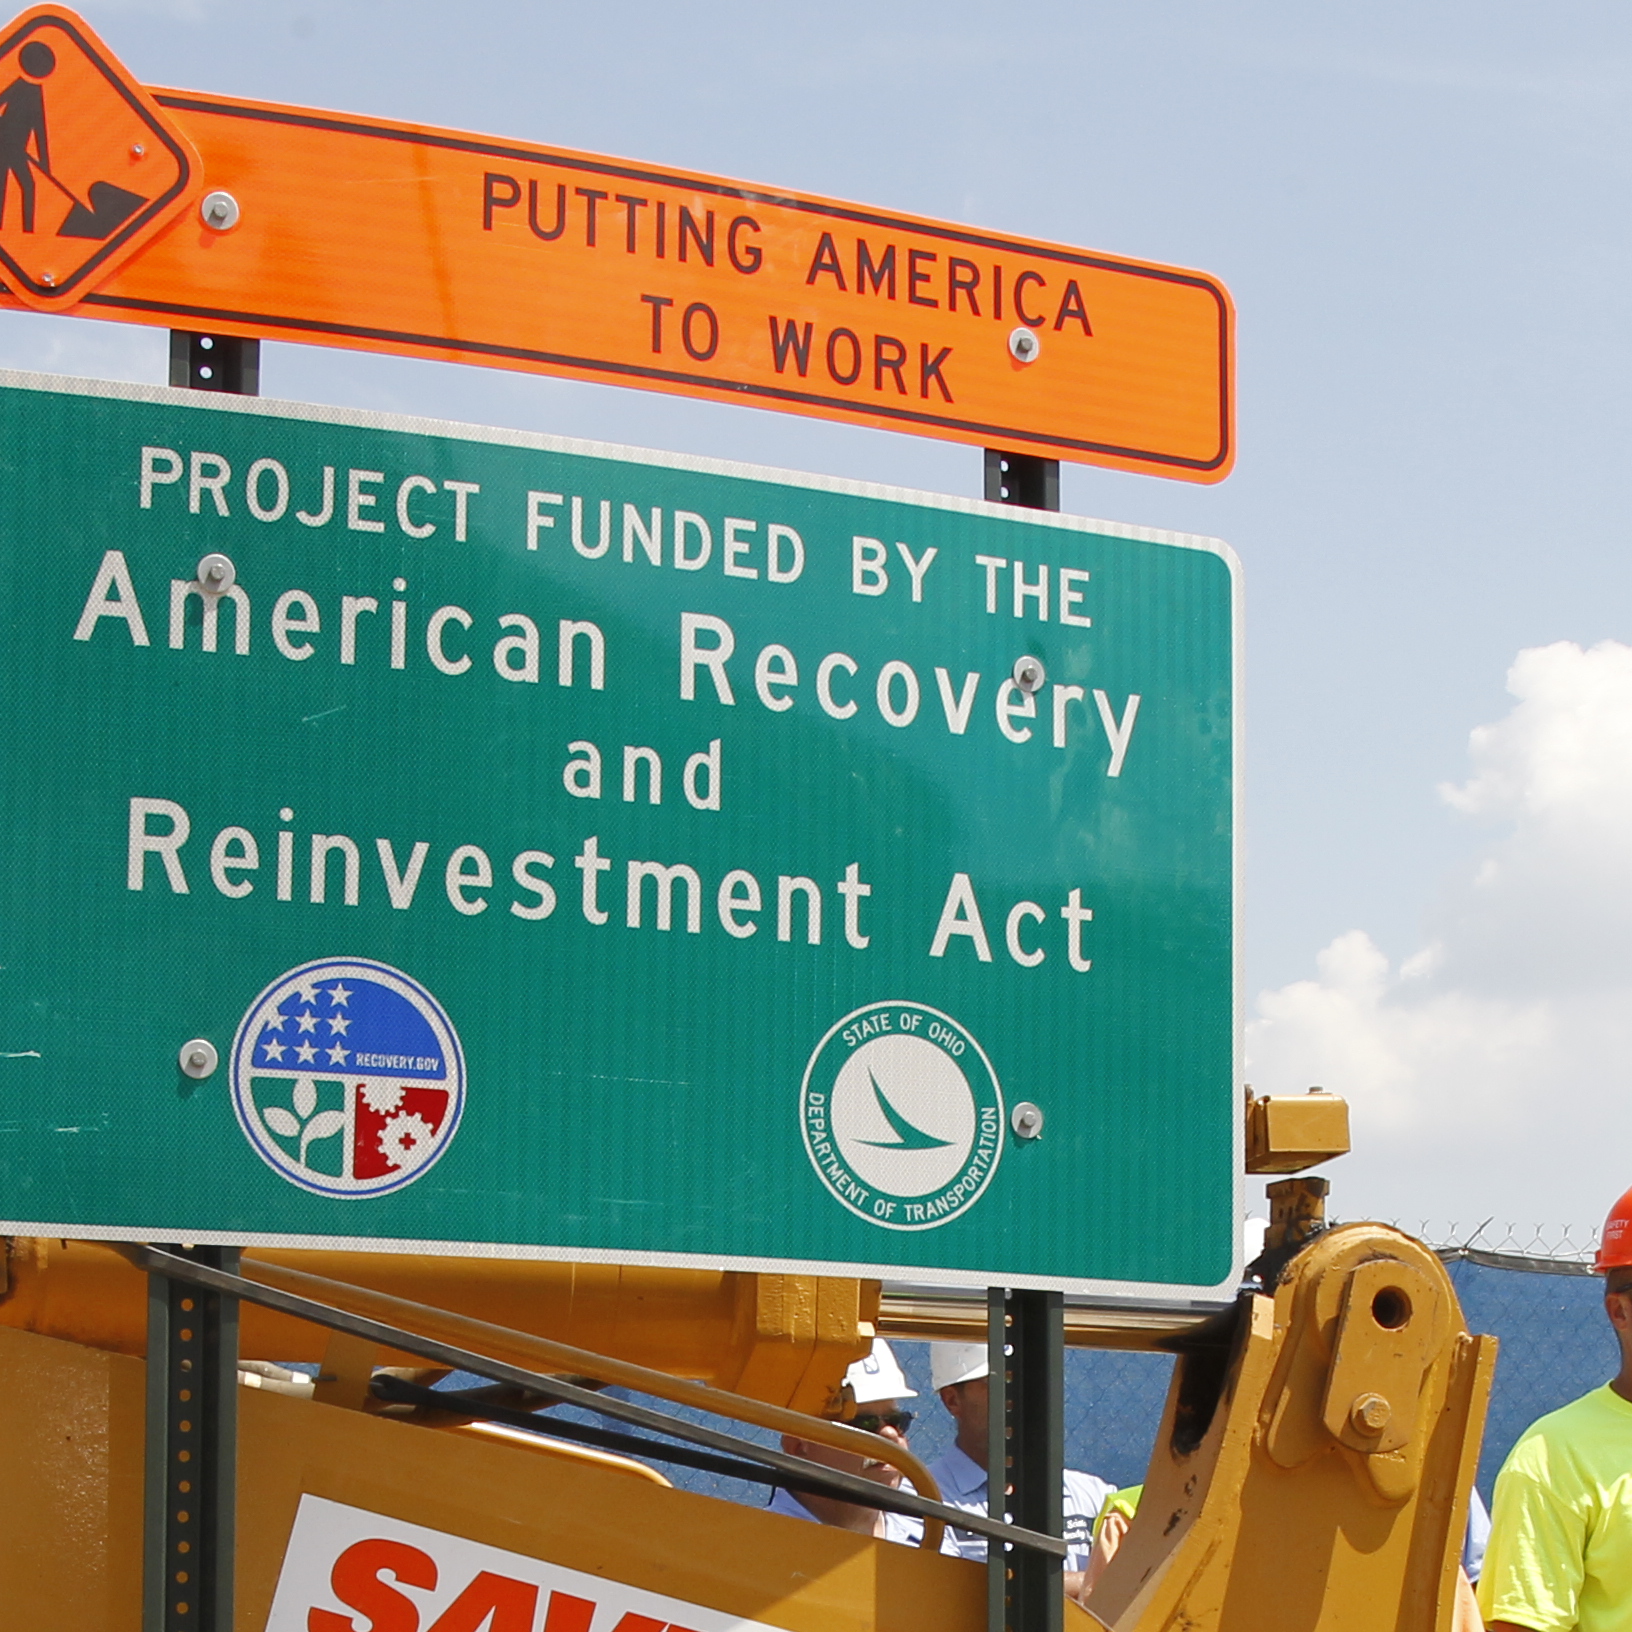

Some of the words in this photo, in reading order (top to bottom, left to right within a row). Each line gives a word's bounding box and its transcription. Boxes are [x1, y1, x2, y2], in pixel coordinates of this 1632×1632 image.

[483, 172, 765, 275] PUTTING
[807, 233, 1095, 340] AMERICA
[641, 293, 719, 362] TO
[769, 319, 956, 404] WORK
[139, 445, 482, 543] PROJECT
[526, 489, 806, 585] FUNDED
[851, 525, 938, 603] BY
[974, 553, 1093, 629] THE
[73, 549, 607, 691] American
[679, 611, 1142, 778] Recovery
[562, 737, 722, 812] and
[126, 795, 872, 950] Reinvestment
[928, 871, 1094, 974] Act
[355, 1052, 440, 1072] RECOVERY.GOV
[842, 1013, 892, 1047] STATE
[899, 1013, 923, 1031] OF
[927, 1021, 966, 1057] OHIO
[808, 1092, 870, 1206] DEPARTMENT
[873, 1199, 897, 1219] OF
[904, 1106, 997, 1222] TRANSPORTATION
